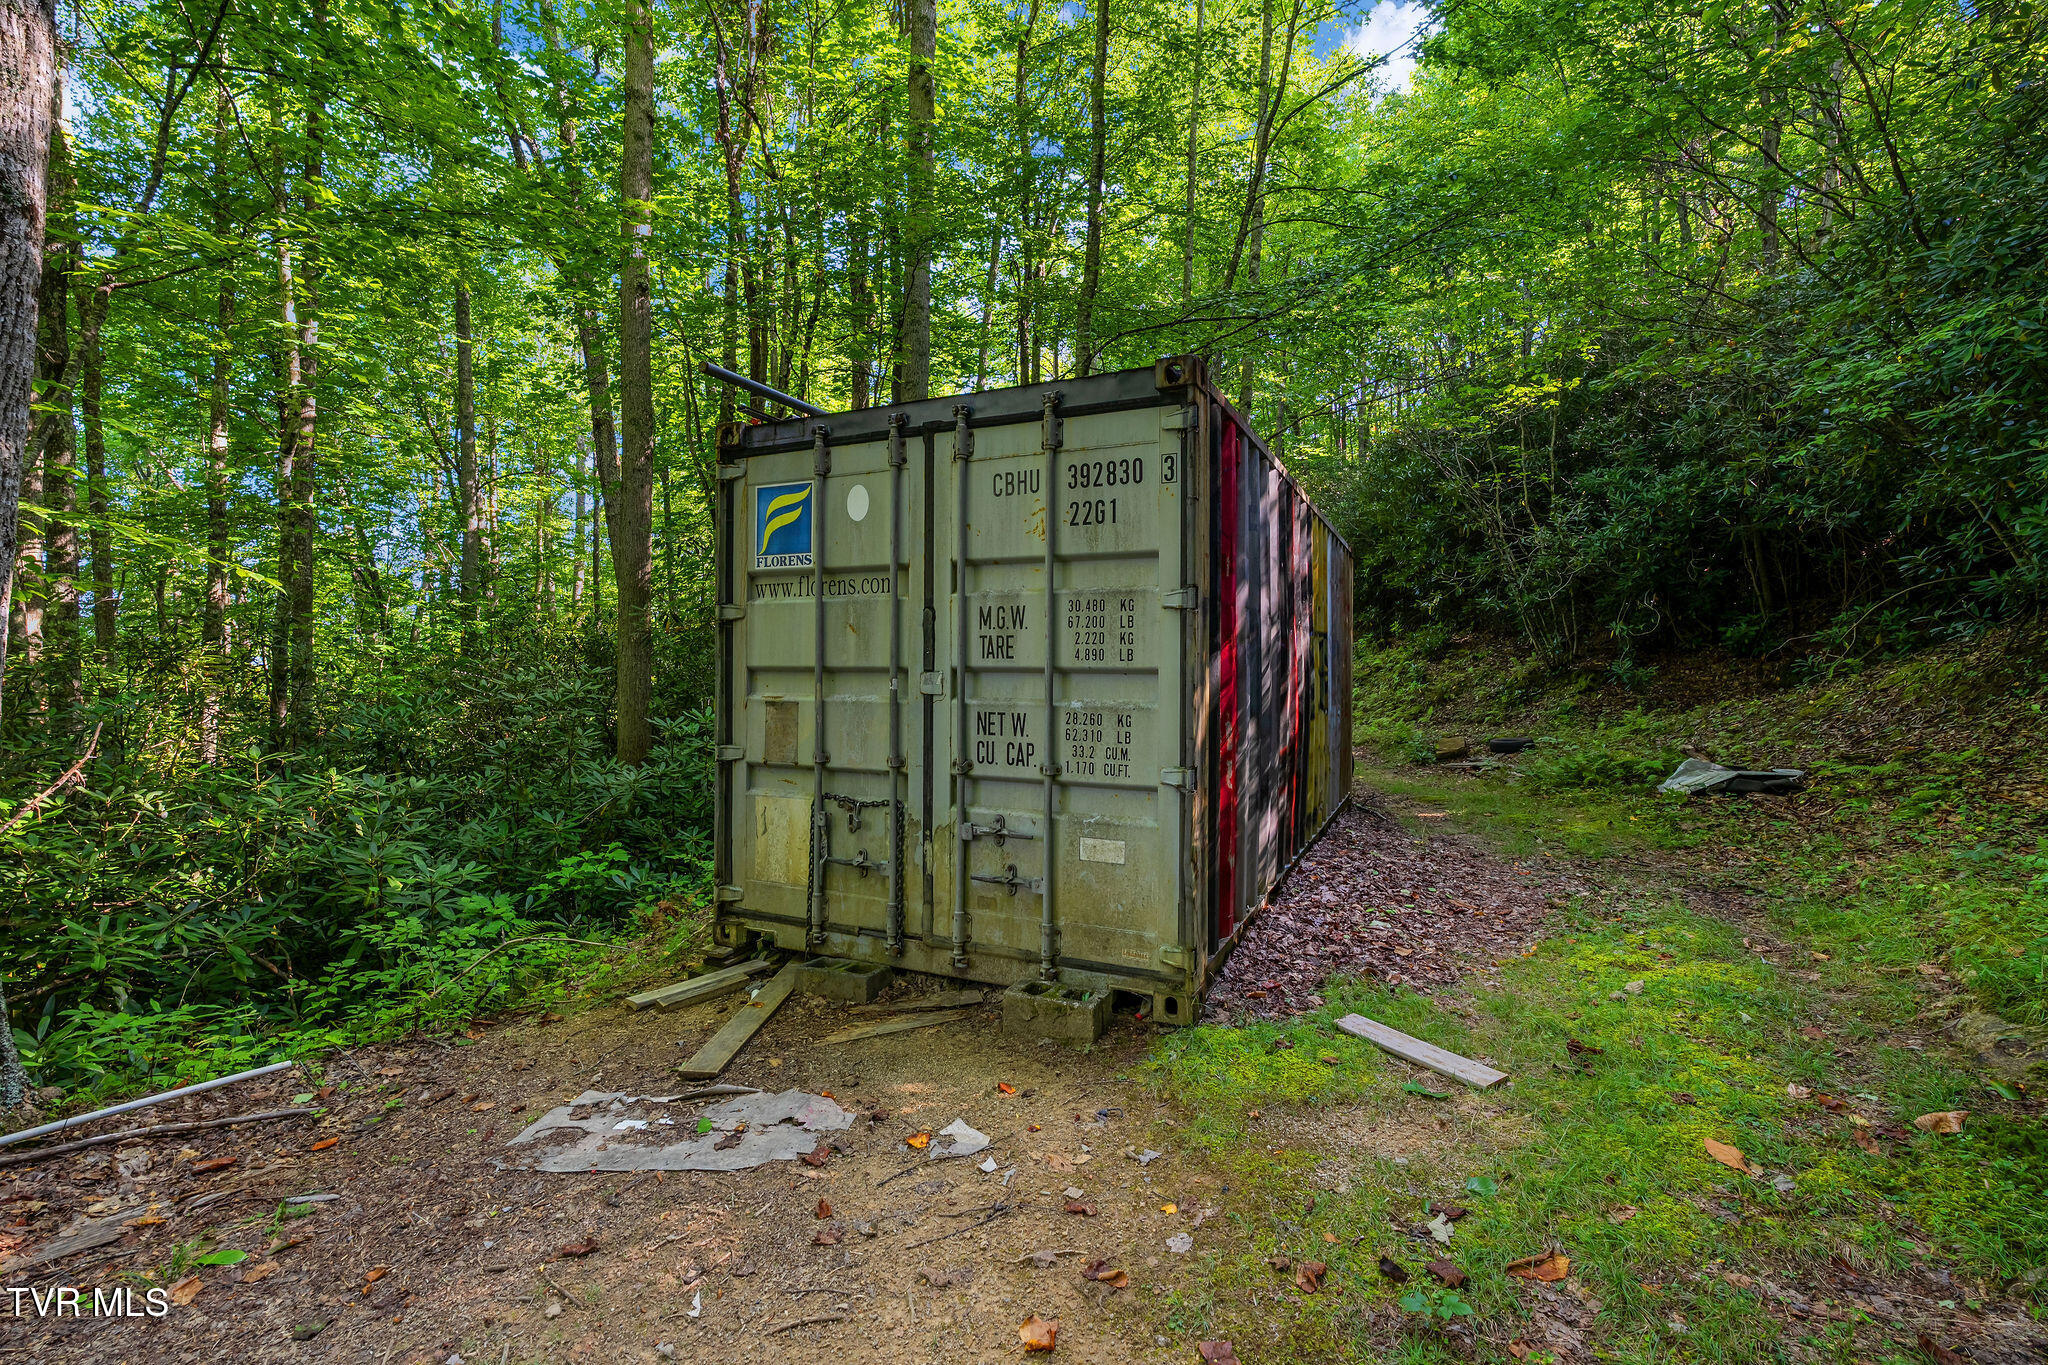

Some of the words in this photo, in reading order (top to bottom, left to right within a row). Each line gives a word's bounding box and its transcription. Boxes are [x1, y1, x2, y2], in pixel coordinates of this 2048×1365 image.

[993, 469, 1040, 497] CBHU
[1067, 457, 1143, 489] 392830
[1163, 455, 1175, 481] 3
[1069, 498, 1117, 526] 22G1
[756, 554, 813, 568] FLORENS
[1120, 599, 1135, 611] KG
[979, 605, 1028, 630] M.G.W.
[1120, 615, 1134, 628] LB
[1119, 632, 1134, 645] KG
[979, 635, 1015, 659] TARE
[1119, 648, 1134, 661] LB
[977, 711, 1005, 737] NET
[1011, 712, 1029, 738] W.
[1117, 714, 1132, 728] KG
[1117, 731, 1131, 744] LB
[977, 741, 998, 765] CU.
[1006, 742, 1037, 768] CAP.
[1072, 745, 1095, 759] 33.2
[1105, 746, 1131, 762] CU.M.
[1103, 763, 1131, 778] CU.FT.
